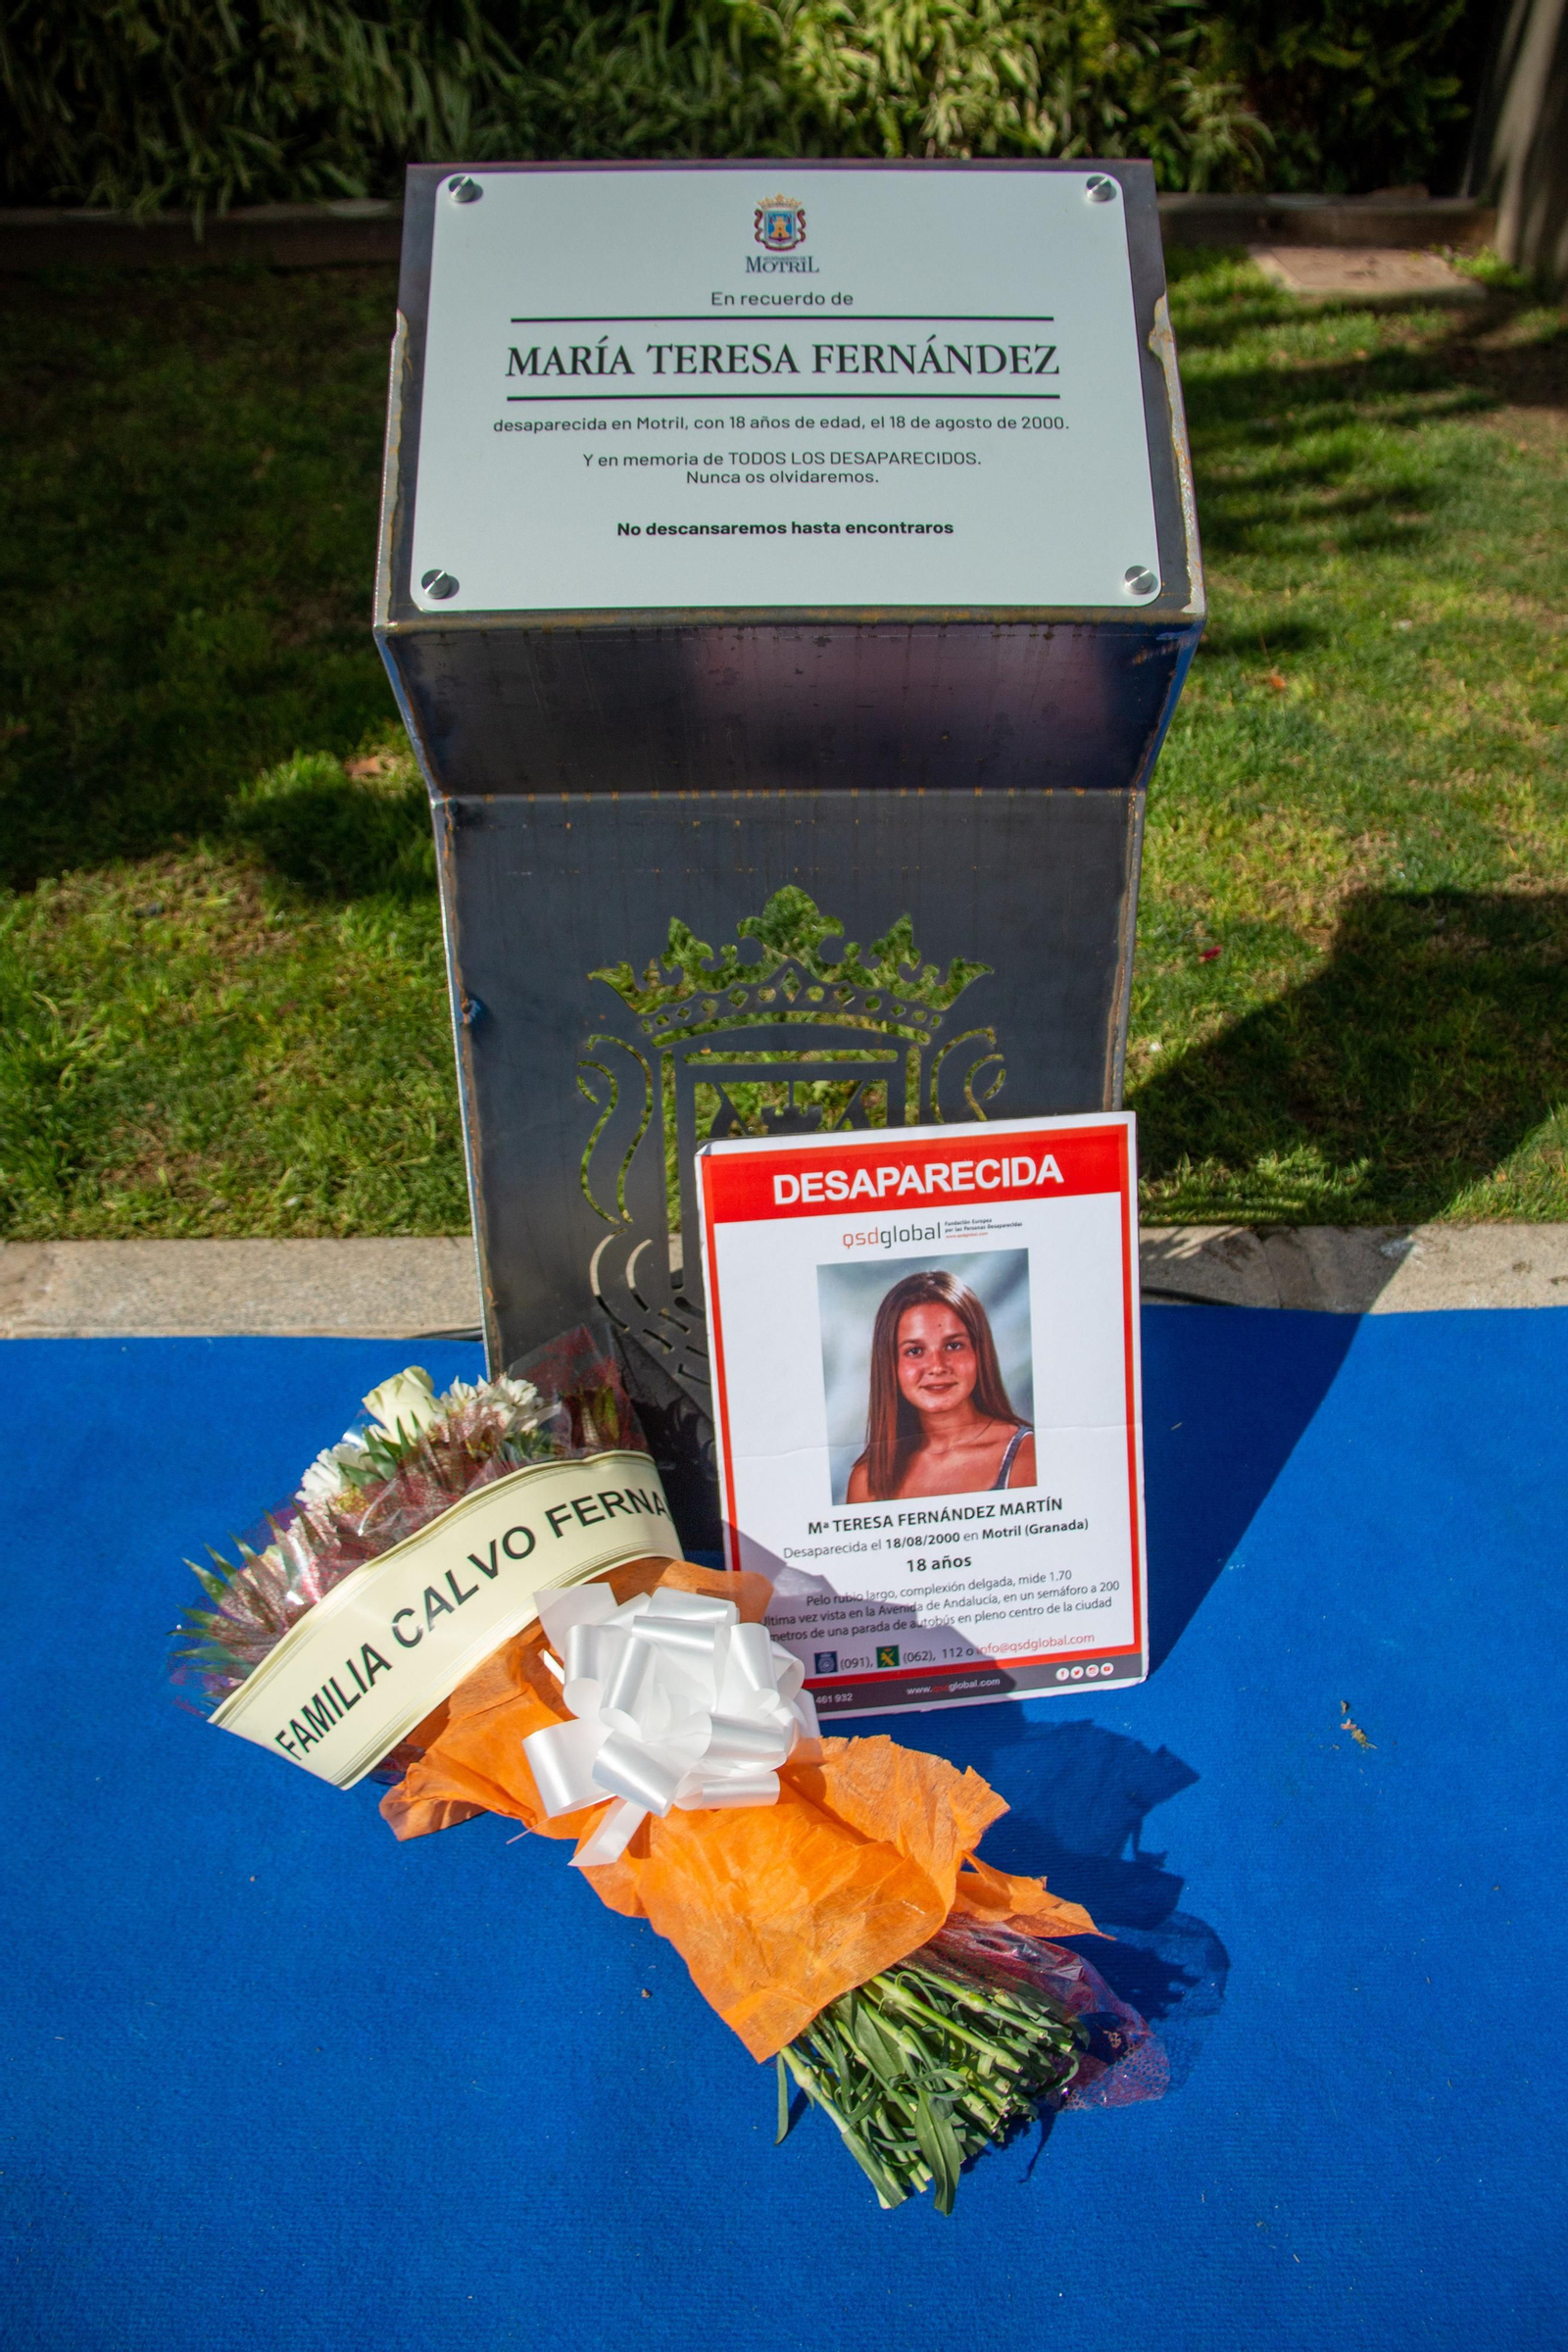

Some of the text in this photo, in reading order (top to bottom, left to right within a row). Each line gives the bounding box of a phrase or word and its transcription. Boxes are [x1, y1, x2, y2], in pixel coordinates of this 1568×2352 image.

[745, 255, 819, 273] MOTRIL
[711, 291, 854, 306] En recuerdo de
[505, 333, 1060, 377] MARÍA TERESA FERNÁNDEZ
[493, 416, 1070, 433] desaparecida en Motril, con 18 años de edad, el 18 de agosto de 2000.
[583, 452, 982, 466] Y en memoria de TODOS LOS DESAPARECIDOS.
[686, 470, 879, 484] Nunca os olvidaremos.
[617, 521, 955, 536] No descansaremos hasta encontraros
[773, 1153, 1065, 1205] DESAPARECIDA
[843, 1221, 941, 1249] qsdglobal
[808, 1496, 1063, 1535] Mª TERESA FERNÁNDEZ MARTÍN
[783, 1518, 1089, 1559] Desaparecida el 18/08/2000 en Motril (Granada)
[906, 1555, 972, 1573] 18 años
[799, 1613, 818, 1623] vez
[820, 1611, 847, 1621] vista
[849, 1609, 863, 1619] en
[866, 1605, 876, 1617] la
[878, 1602, 924, 1616] Avenida
[926, 1599, 941, 1611] de
[943, 1592, 1001, 1610] Andalucía,
[1004, 1592, 1017, 1603] en
[1020, 1590, 1035, 1600] un
[1037, 1586, 1088, 1599] semáforo
[1090, 1584, 1098, 1593] a
[1100, 1580, 1119, 1592] 200
[806, 1570, 1072, 1607] Pelo rubio largo, complexión delgada, mide 1.70
[275, 1488, 672, 1761] FAMILIA CALVO FERNA
[770, 1596, 1112, 1642] metros de una parada de autobús en pleno centro de la ciudad
[840, 1634, 1096, 1671] (091), (062), 112 o info@qsdglobal.com
[835, 1692, 853, 1703] 932
